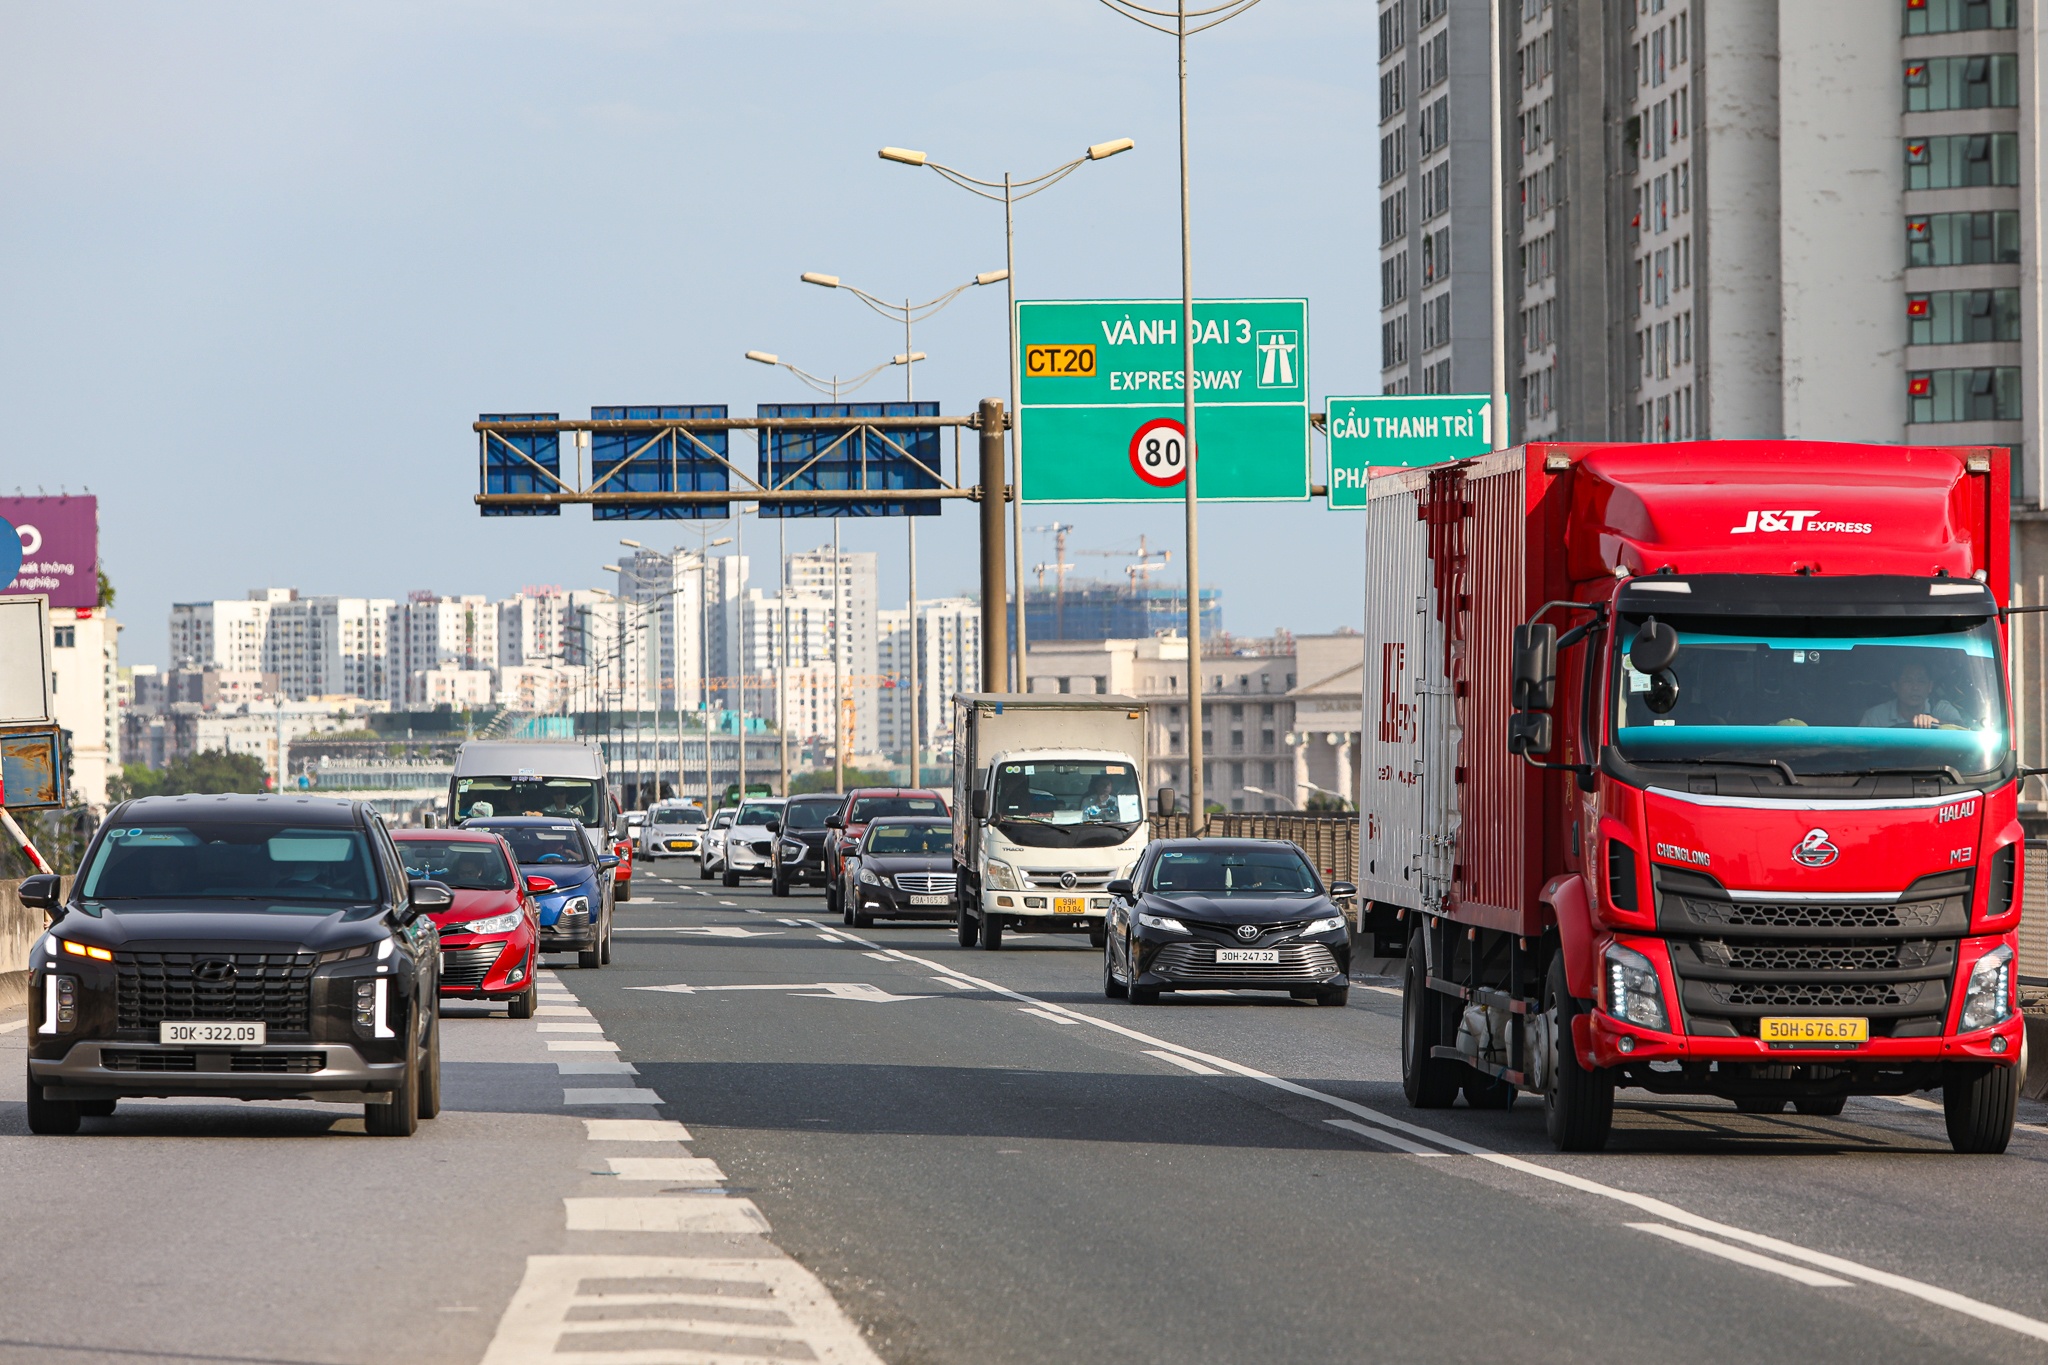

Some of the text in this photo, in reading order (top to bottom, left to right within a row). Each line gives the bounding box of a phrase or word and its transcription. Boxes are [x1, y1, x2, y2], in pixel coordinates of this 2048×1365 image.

[1101, 313, 1177, 345] VÀNH
[1235, 318, 1252, 344] 3
[1028, 348, 1094, 373] CT.20
[1109, 369, 1243, 390] EXPRESSWAY
[1373, 416, 1439, 439] THANH
[1441, 408, 1474, 437] TRÌ
[1145, 438, 1181, 467] 80
[1730, 510, 1872, 534] J&T EXPRESS
[1939, 800, 1975, 824] HALAU
[1656, 842, 1711, 867] CHENGLONG
[1949, 846, 1972, 865] M3
[1221, 952, 1274, 961] 30H-247.32
[170, 1026, 256, 1041] 30K-322.09
[1770, 1022, 1858, 1037] 50H-676.67
